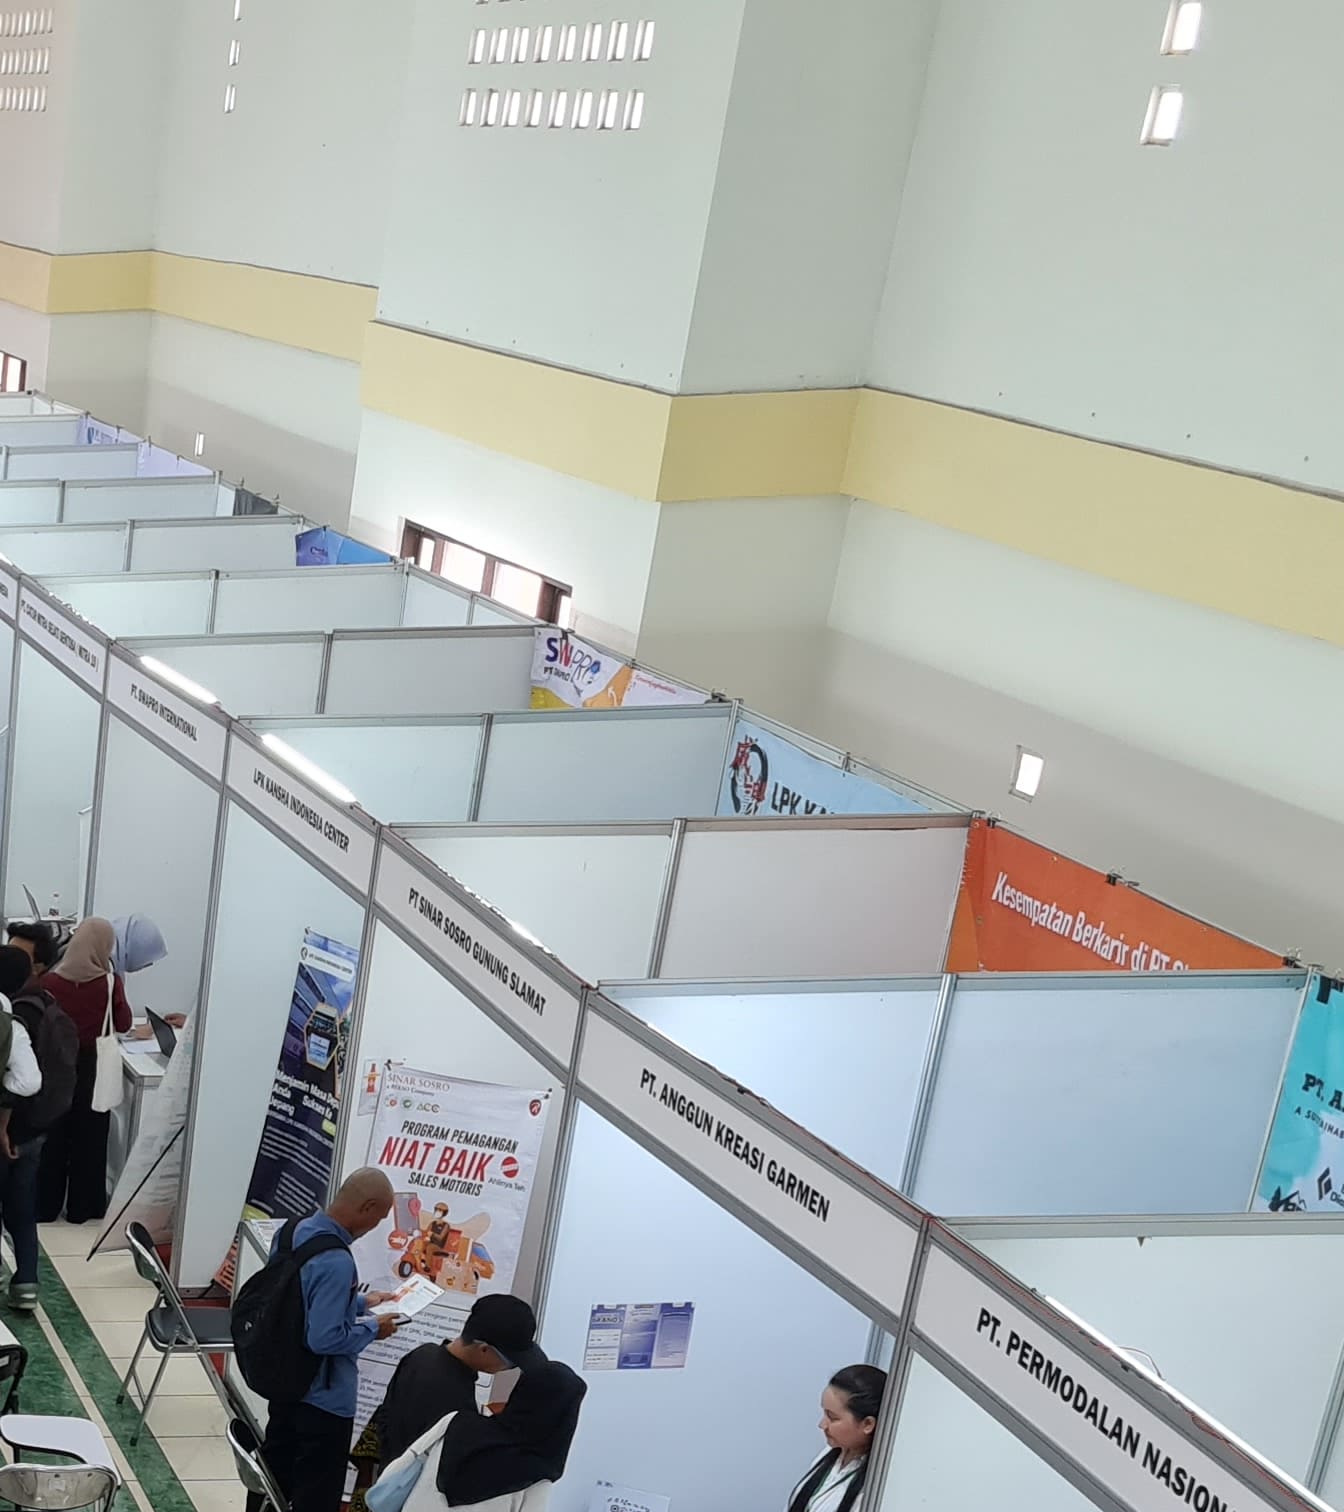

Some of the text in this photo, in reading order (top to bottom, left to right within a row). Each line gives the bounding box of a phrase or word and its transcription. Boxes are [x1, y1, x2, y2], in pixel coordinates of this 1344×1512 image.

[159, 701, 197, 742] INTERNATIONAL
[254, 767, 349, 853] LPK KANSHA INDONESIA CENTER
[771, 781, 802, 815] LPK
[992, 871, 1073, 938] Kesempatan
[1072, 911, 1129, 967] Berkarir
[1131, 946, 1147, 972] di
[408, 887, 547, 1017] PT SINAR SOSRO GUNUNG SLAMAT
[387, 1073, 450, 1092] SINAR SOSRO
[1302, 1073, 1324, 1101] PT.
[401, 1120, 519, 1154] PROGRAM PEMAGANGAN
[640, 1068, 831, 1222] PT. ANGGUN KREASI GARMEN
[379, 1136, 494, 1182] NIAT BAIK
[408, 1172, 483, 1196] SALES MOTORIS
[976, 1308, 1002, 1349] PT.
[1005, 1331, 1140, 1460] PERMODALAN
